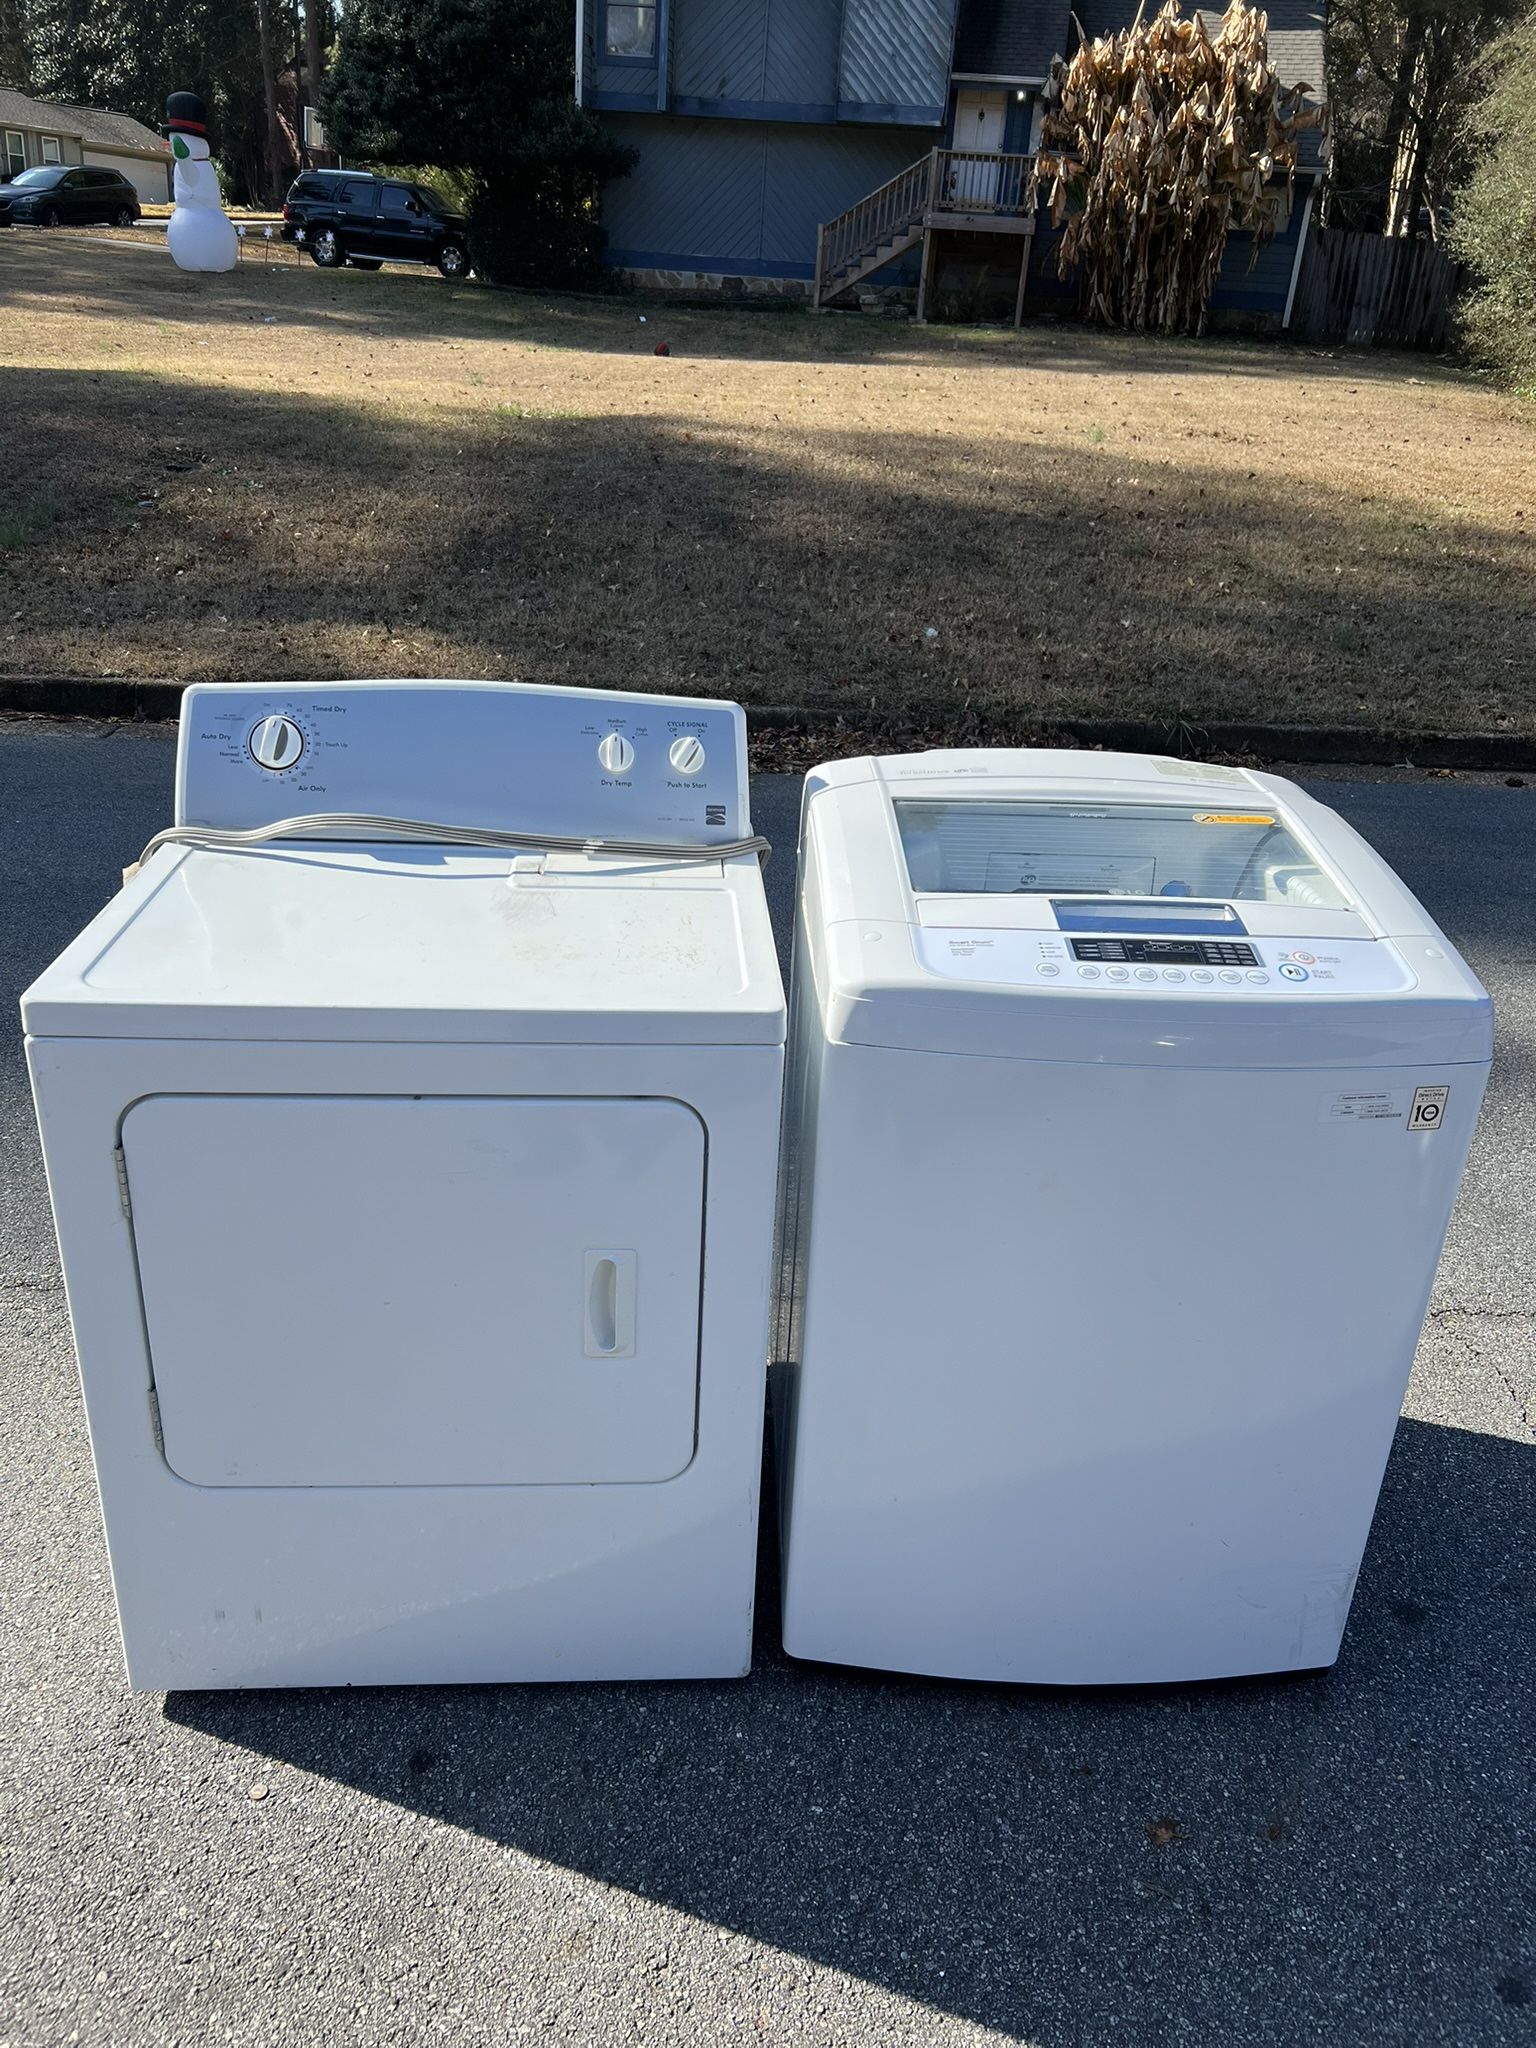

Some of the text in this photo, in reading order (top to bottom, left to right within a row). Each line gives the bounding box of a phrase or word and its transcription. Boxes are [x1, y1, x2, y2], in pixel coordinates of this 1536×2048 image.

[218, 733, 232, 741] Dry
[600, 779, 632, 788] Dry Temp
[667, 781, 682, 789] Push
[310, 785, 326, 793] Only
[1414, 1104, 1440, 1122] 10
